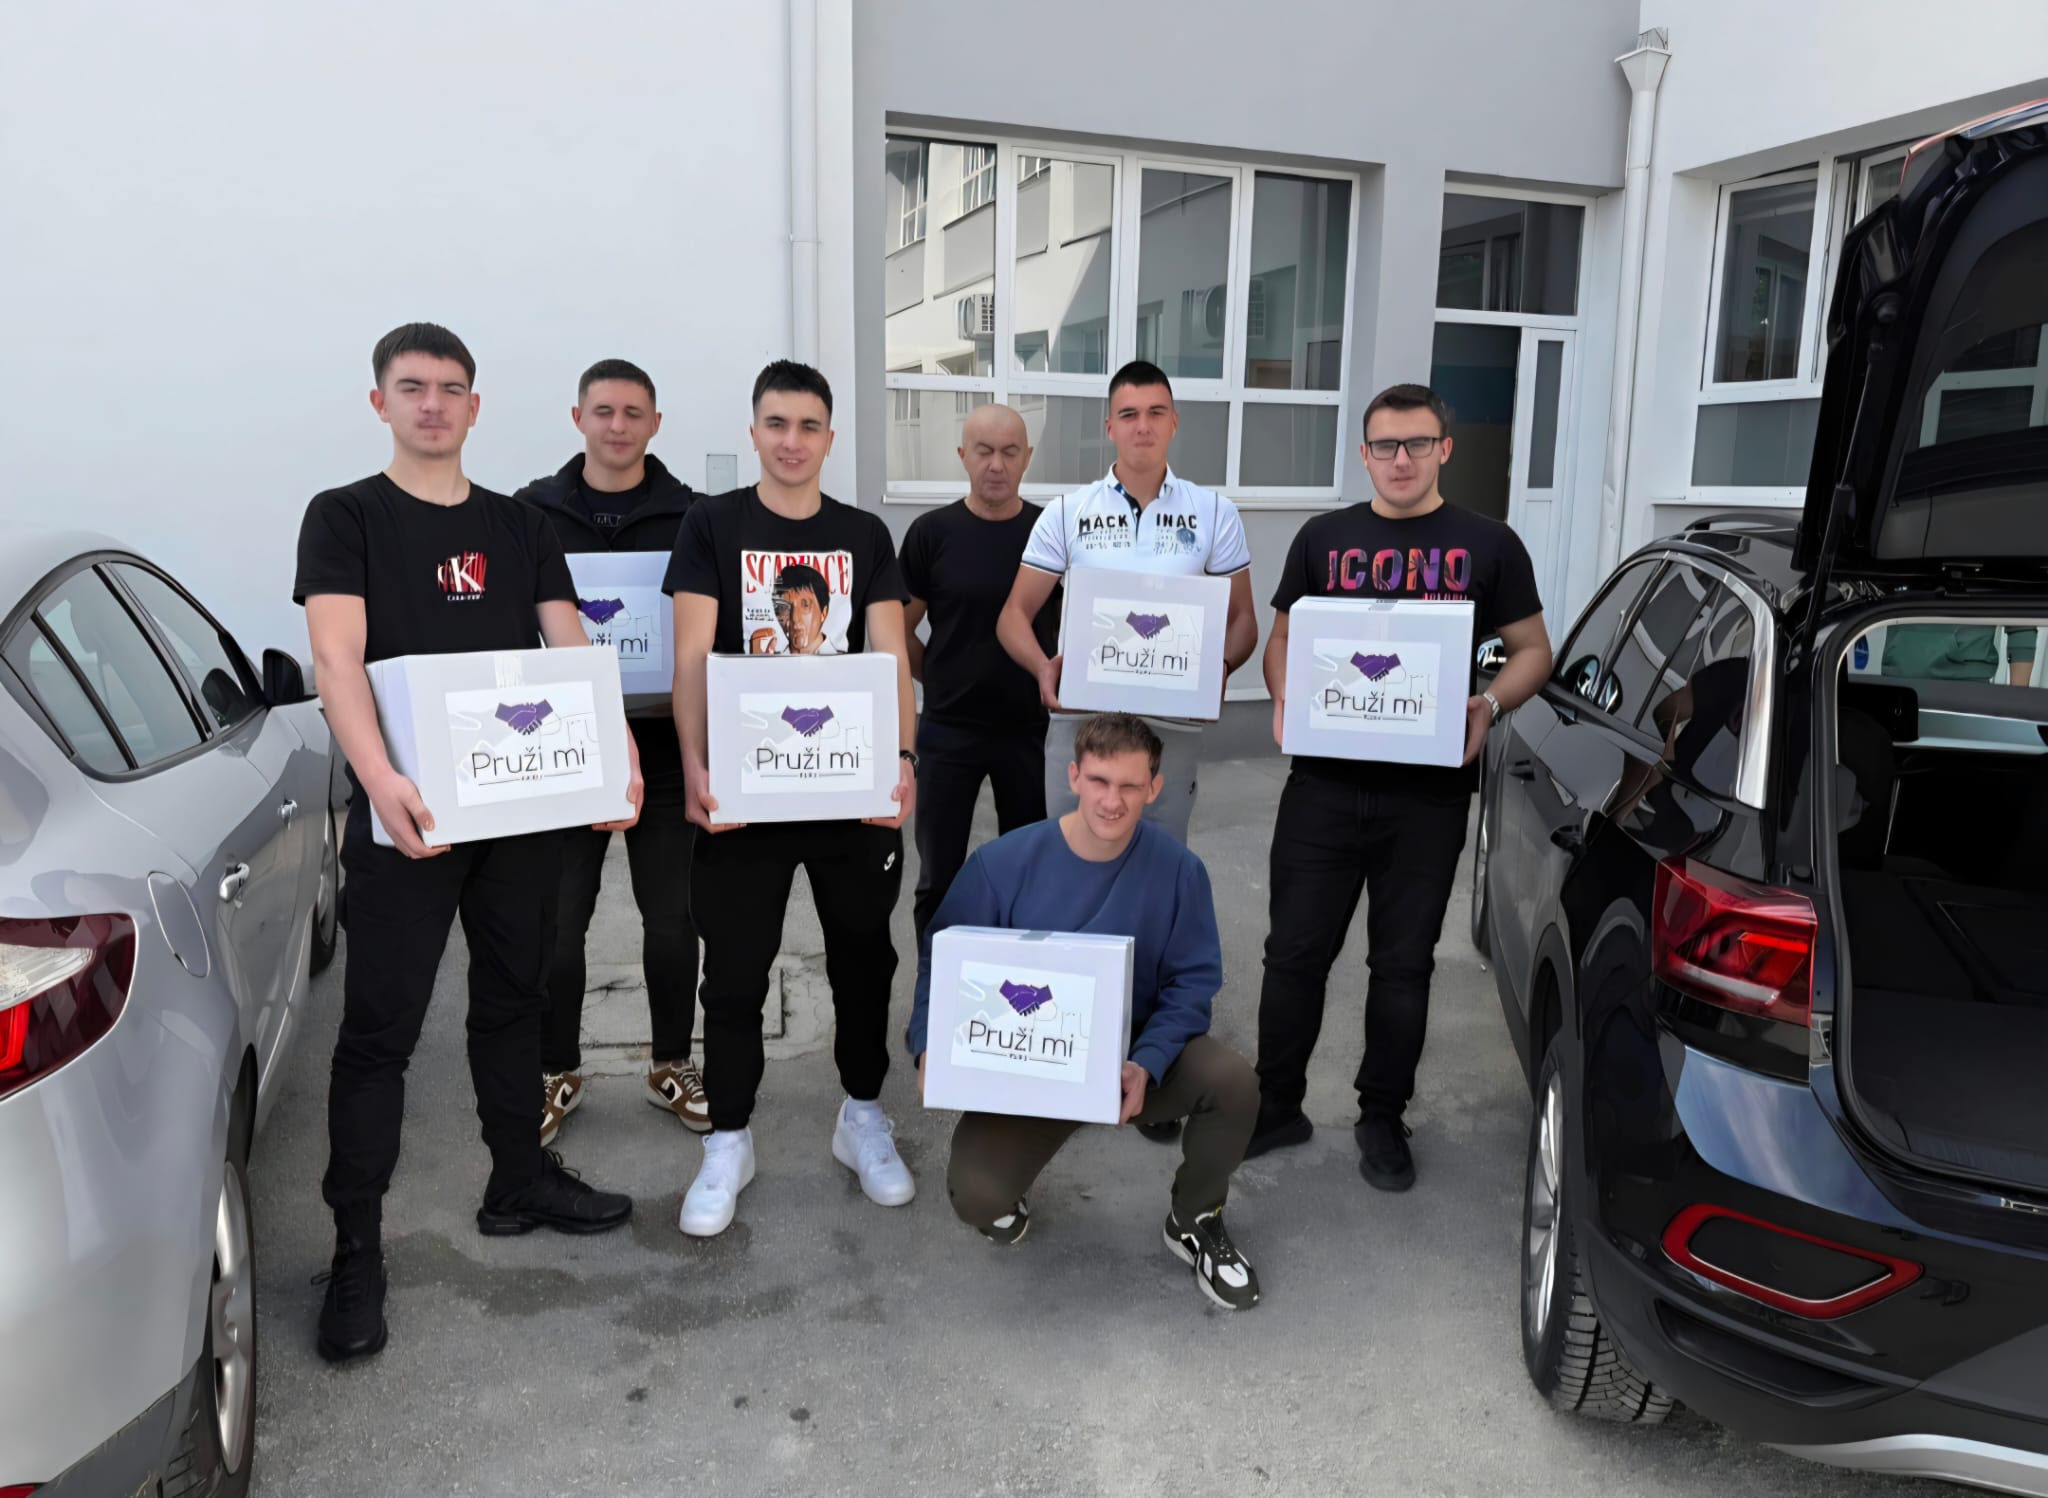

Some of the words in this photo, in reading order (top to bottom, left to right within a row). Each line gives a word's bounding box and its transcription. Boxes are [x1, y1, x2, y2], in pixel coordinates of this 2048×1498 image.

[1079, 513, 1129, 536] MACK
[1327, 548, 1472, 591] ICONO
[620, 632, 648, 653] mi
[1101, 645, 1156, 668] Pruži
[1163, 651, 1188, 671] mi
[1324, 688, 1385, 713] Pruži
[1393, 693, 1423, 715] mi
[472, 746, 543, 778] Pruži
[553, 740, 585, 768] mi
[756, 747, 820, 770] Pruži
[830, 746, 859, 768] mi
[969, 1019, 1034, 1052] Pruži
[1042, 1033, 1074, 1058] mi
